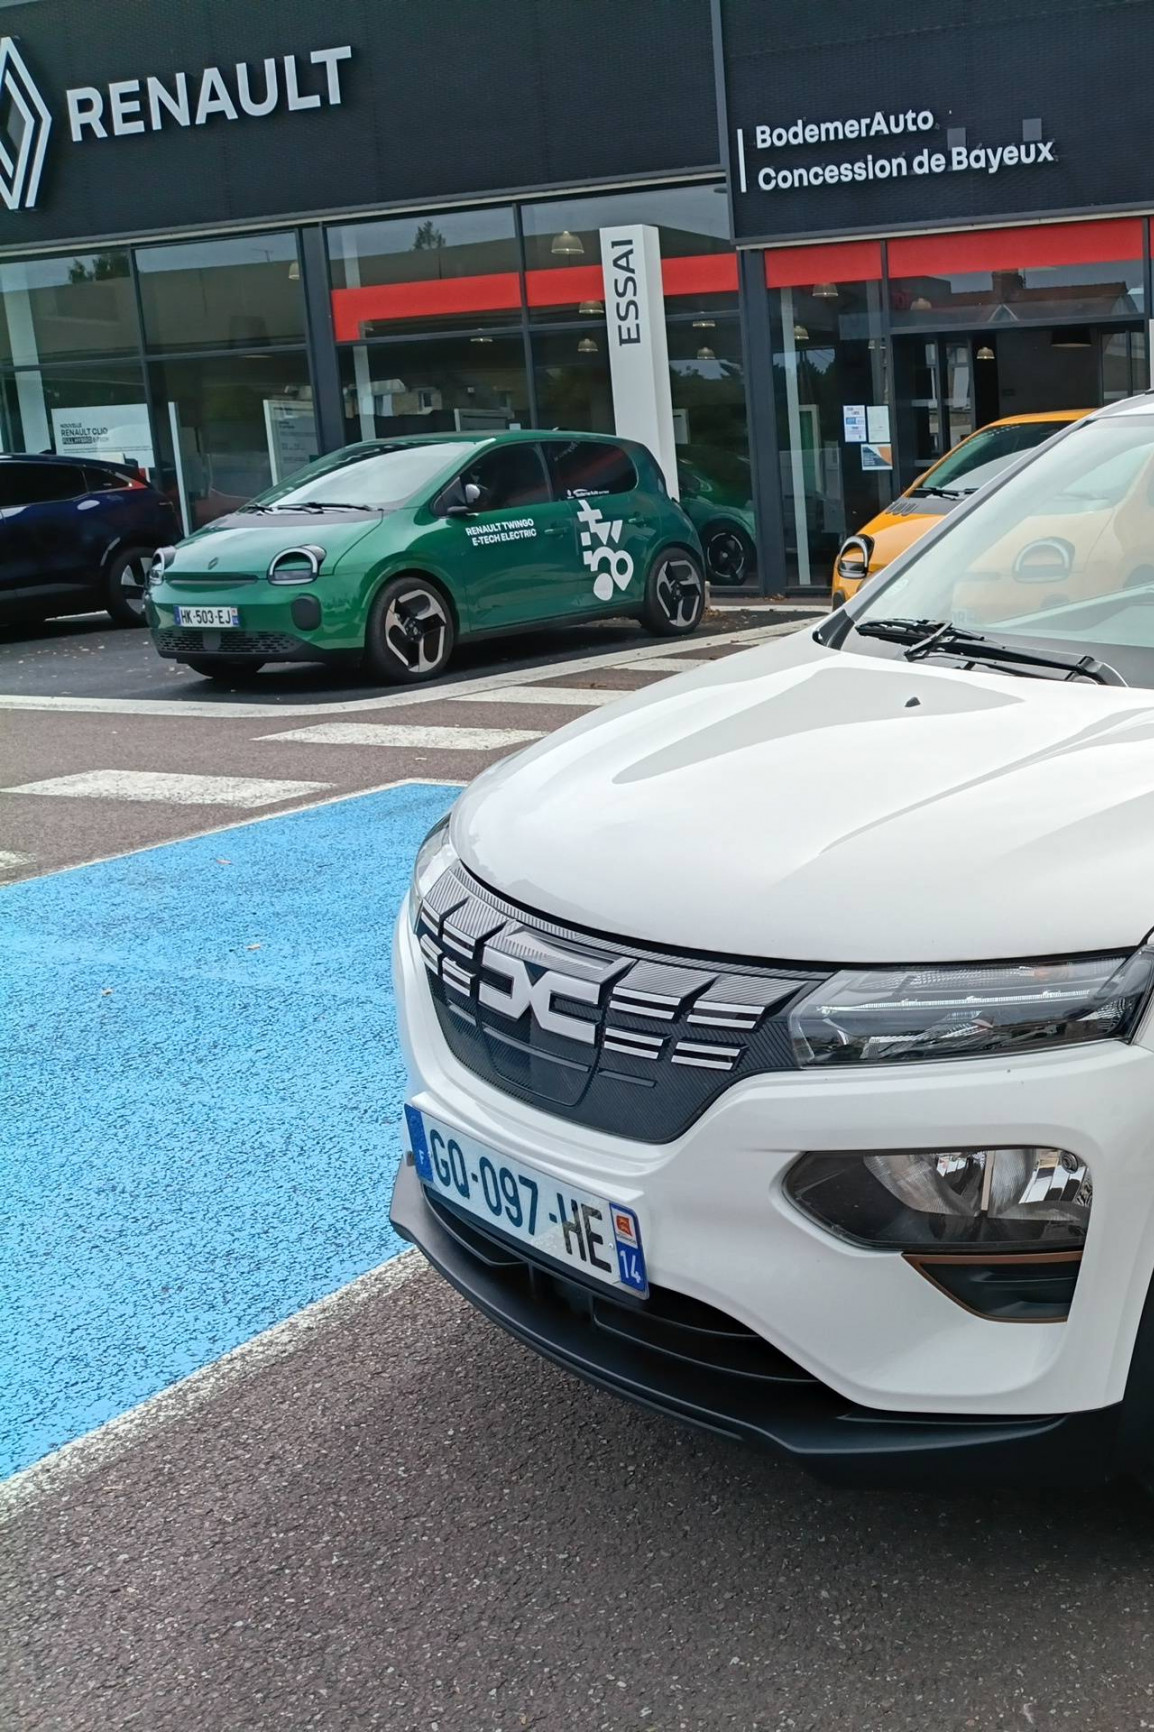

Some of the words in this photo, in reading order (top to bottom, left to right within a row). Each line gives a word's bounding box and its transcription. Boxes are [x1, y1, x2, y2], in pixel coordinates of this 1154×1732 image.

[66, 46, 352, 142] RENAULT
[755, 109, 934, 149] BodemerAuto
[758, 154, 907, 191] Concession
[912, 149, 946, 175] de
[951, 141, 1055, 173] Bayeux
[611, 239, 641, 346] ESSAI
[60, 428, 91, 437] RENAULT
[92, 427, 108, 435] CLIO
[465, 523, 502, 536] RENAULT
[502, 518, 534, 530] TWINGO
[472, 533, 501, 546] E-TECH
[501, 528, 537, 542] ELECTRIC
[180, 609, 231, 624] HK-503-EJ
[429, 1129, 612, 1273] GQ-097-HE
[620, 1250, 642, 1283] 14
